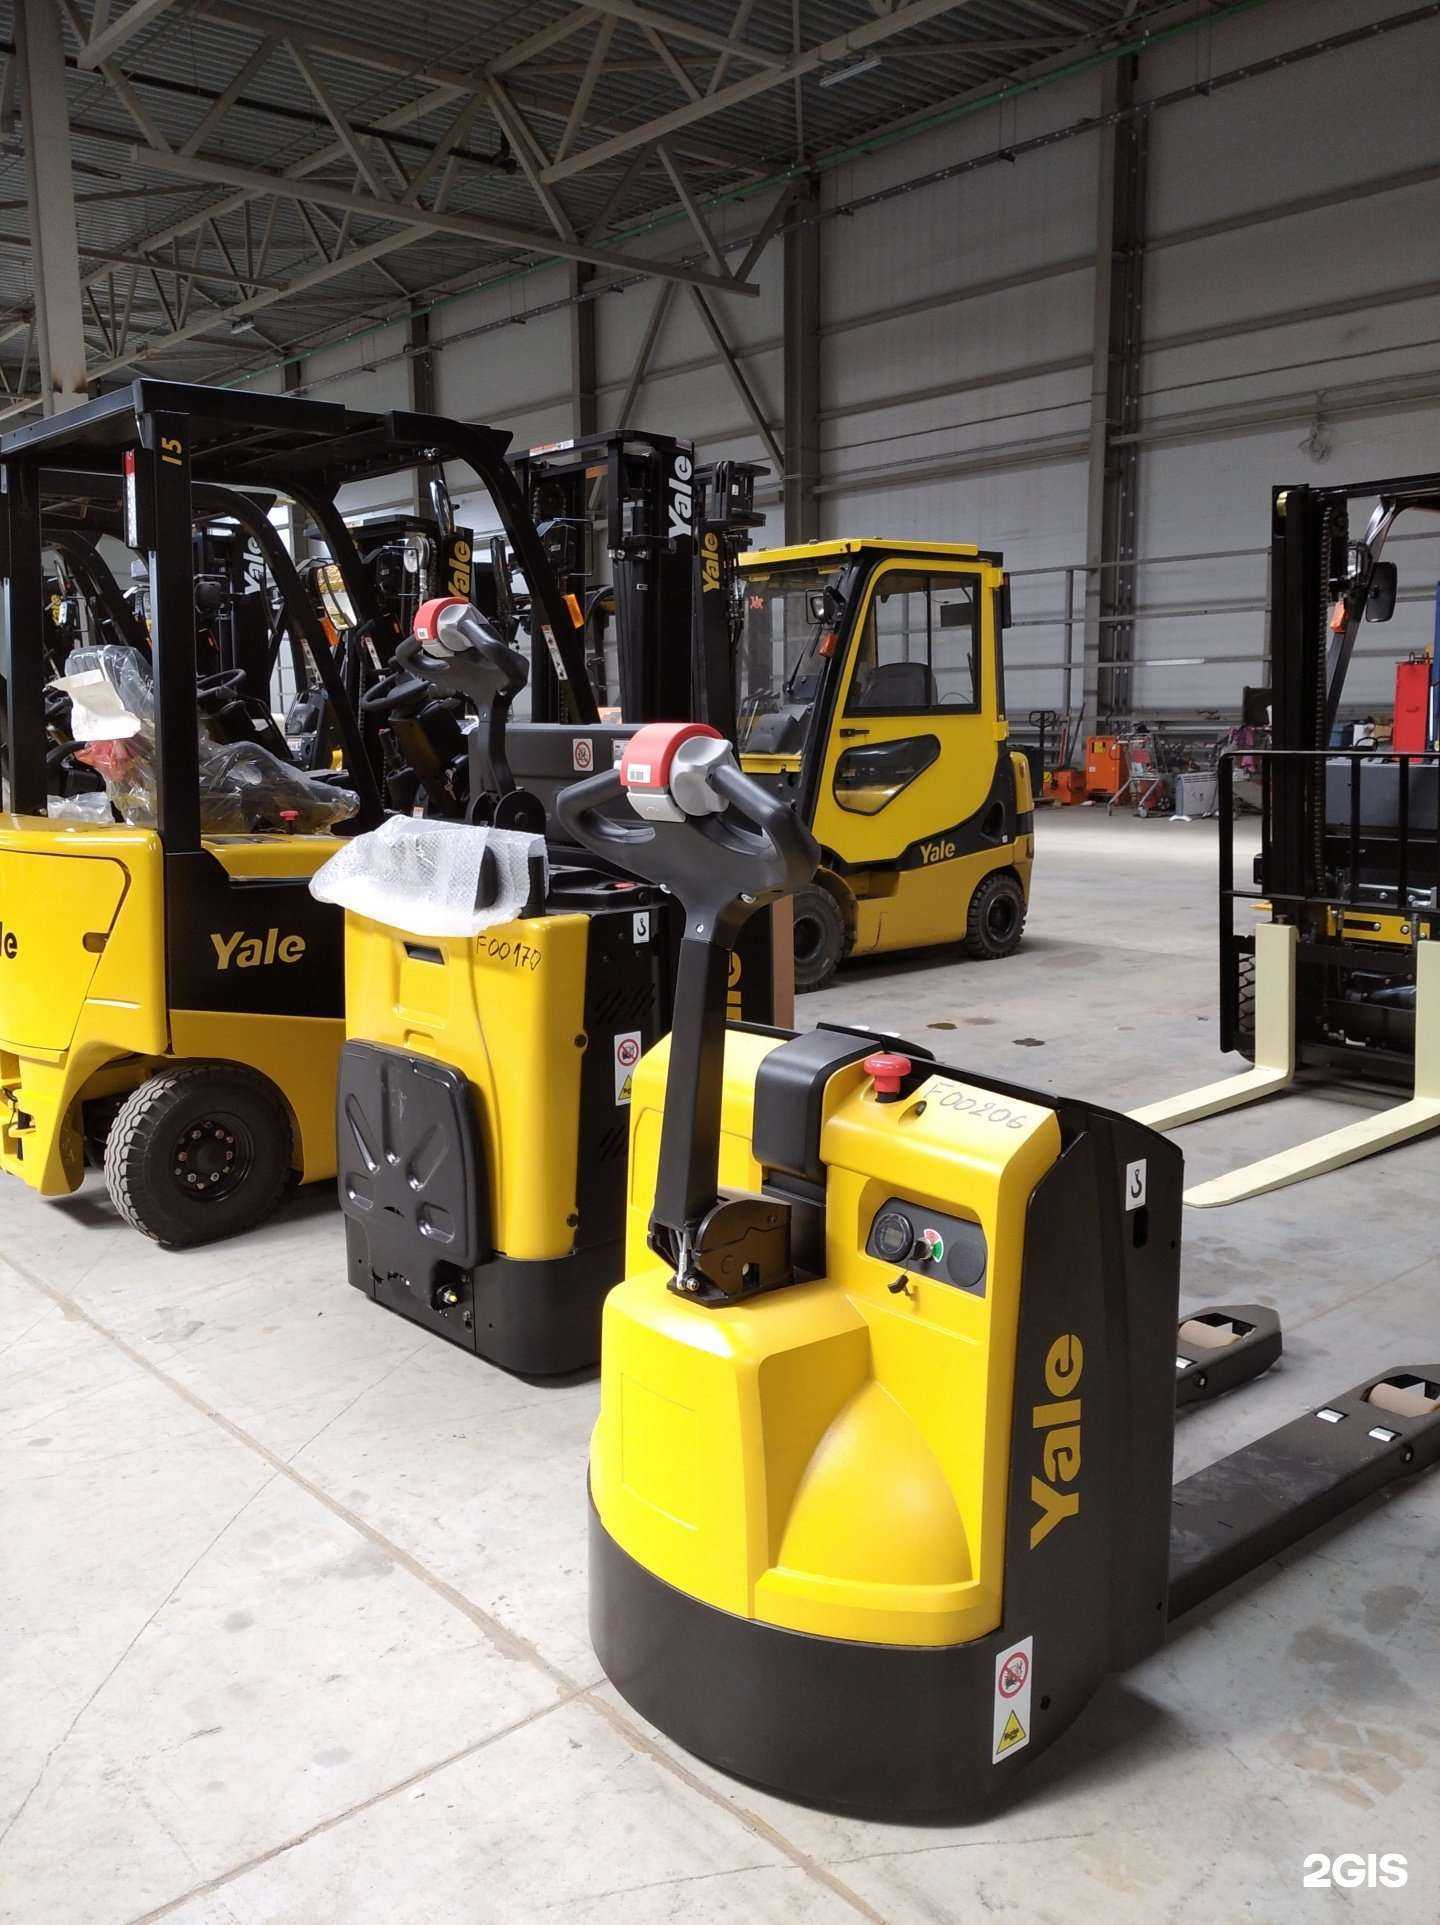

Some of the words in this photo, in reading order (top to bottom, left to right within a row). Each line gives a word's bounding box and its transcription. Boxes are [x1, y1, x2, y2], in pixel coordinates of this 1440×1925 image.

[161, 437, 182, 466] 15
[669, 455, 693, 538] Yale
[702, 532, 720, 593] Yale
[920, 839, 956, 865] Yale
[210, 927, 306, 970] Yale
[476, 935, 542, 971] F00170
[923, 1082, 1027, 1129] F00206
[1030, 1334, 1084, 1550] Yale
